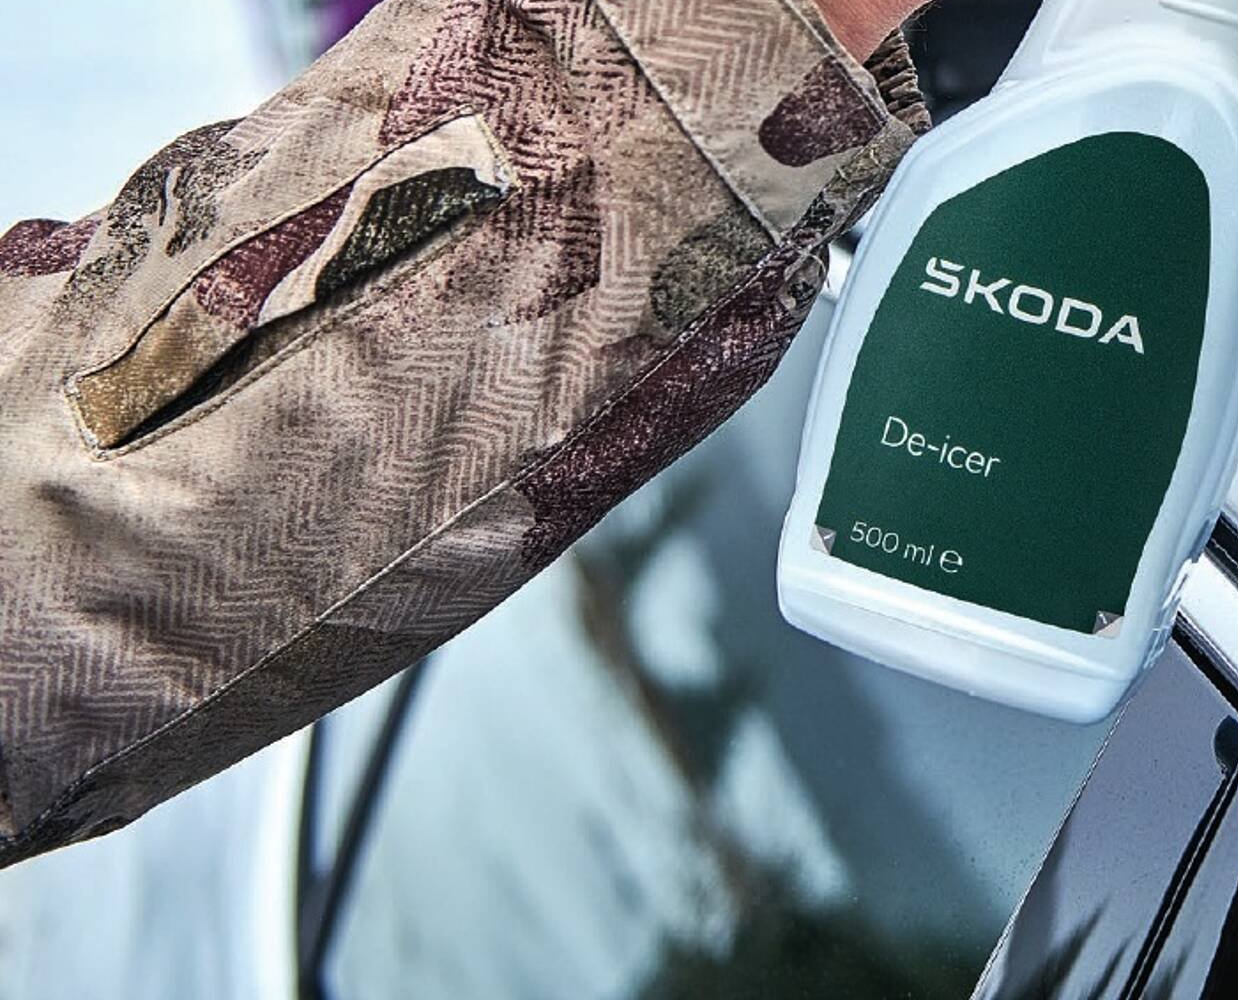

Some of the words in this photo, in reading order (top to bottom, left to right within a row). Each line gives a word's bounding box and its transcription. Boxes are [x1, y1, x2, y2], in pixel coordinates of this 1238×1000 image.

[880, 415, 1000, 478] De-icer
[850, 521, 899, 554] 500
[902, 543, 935, 566] ml
